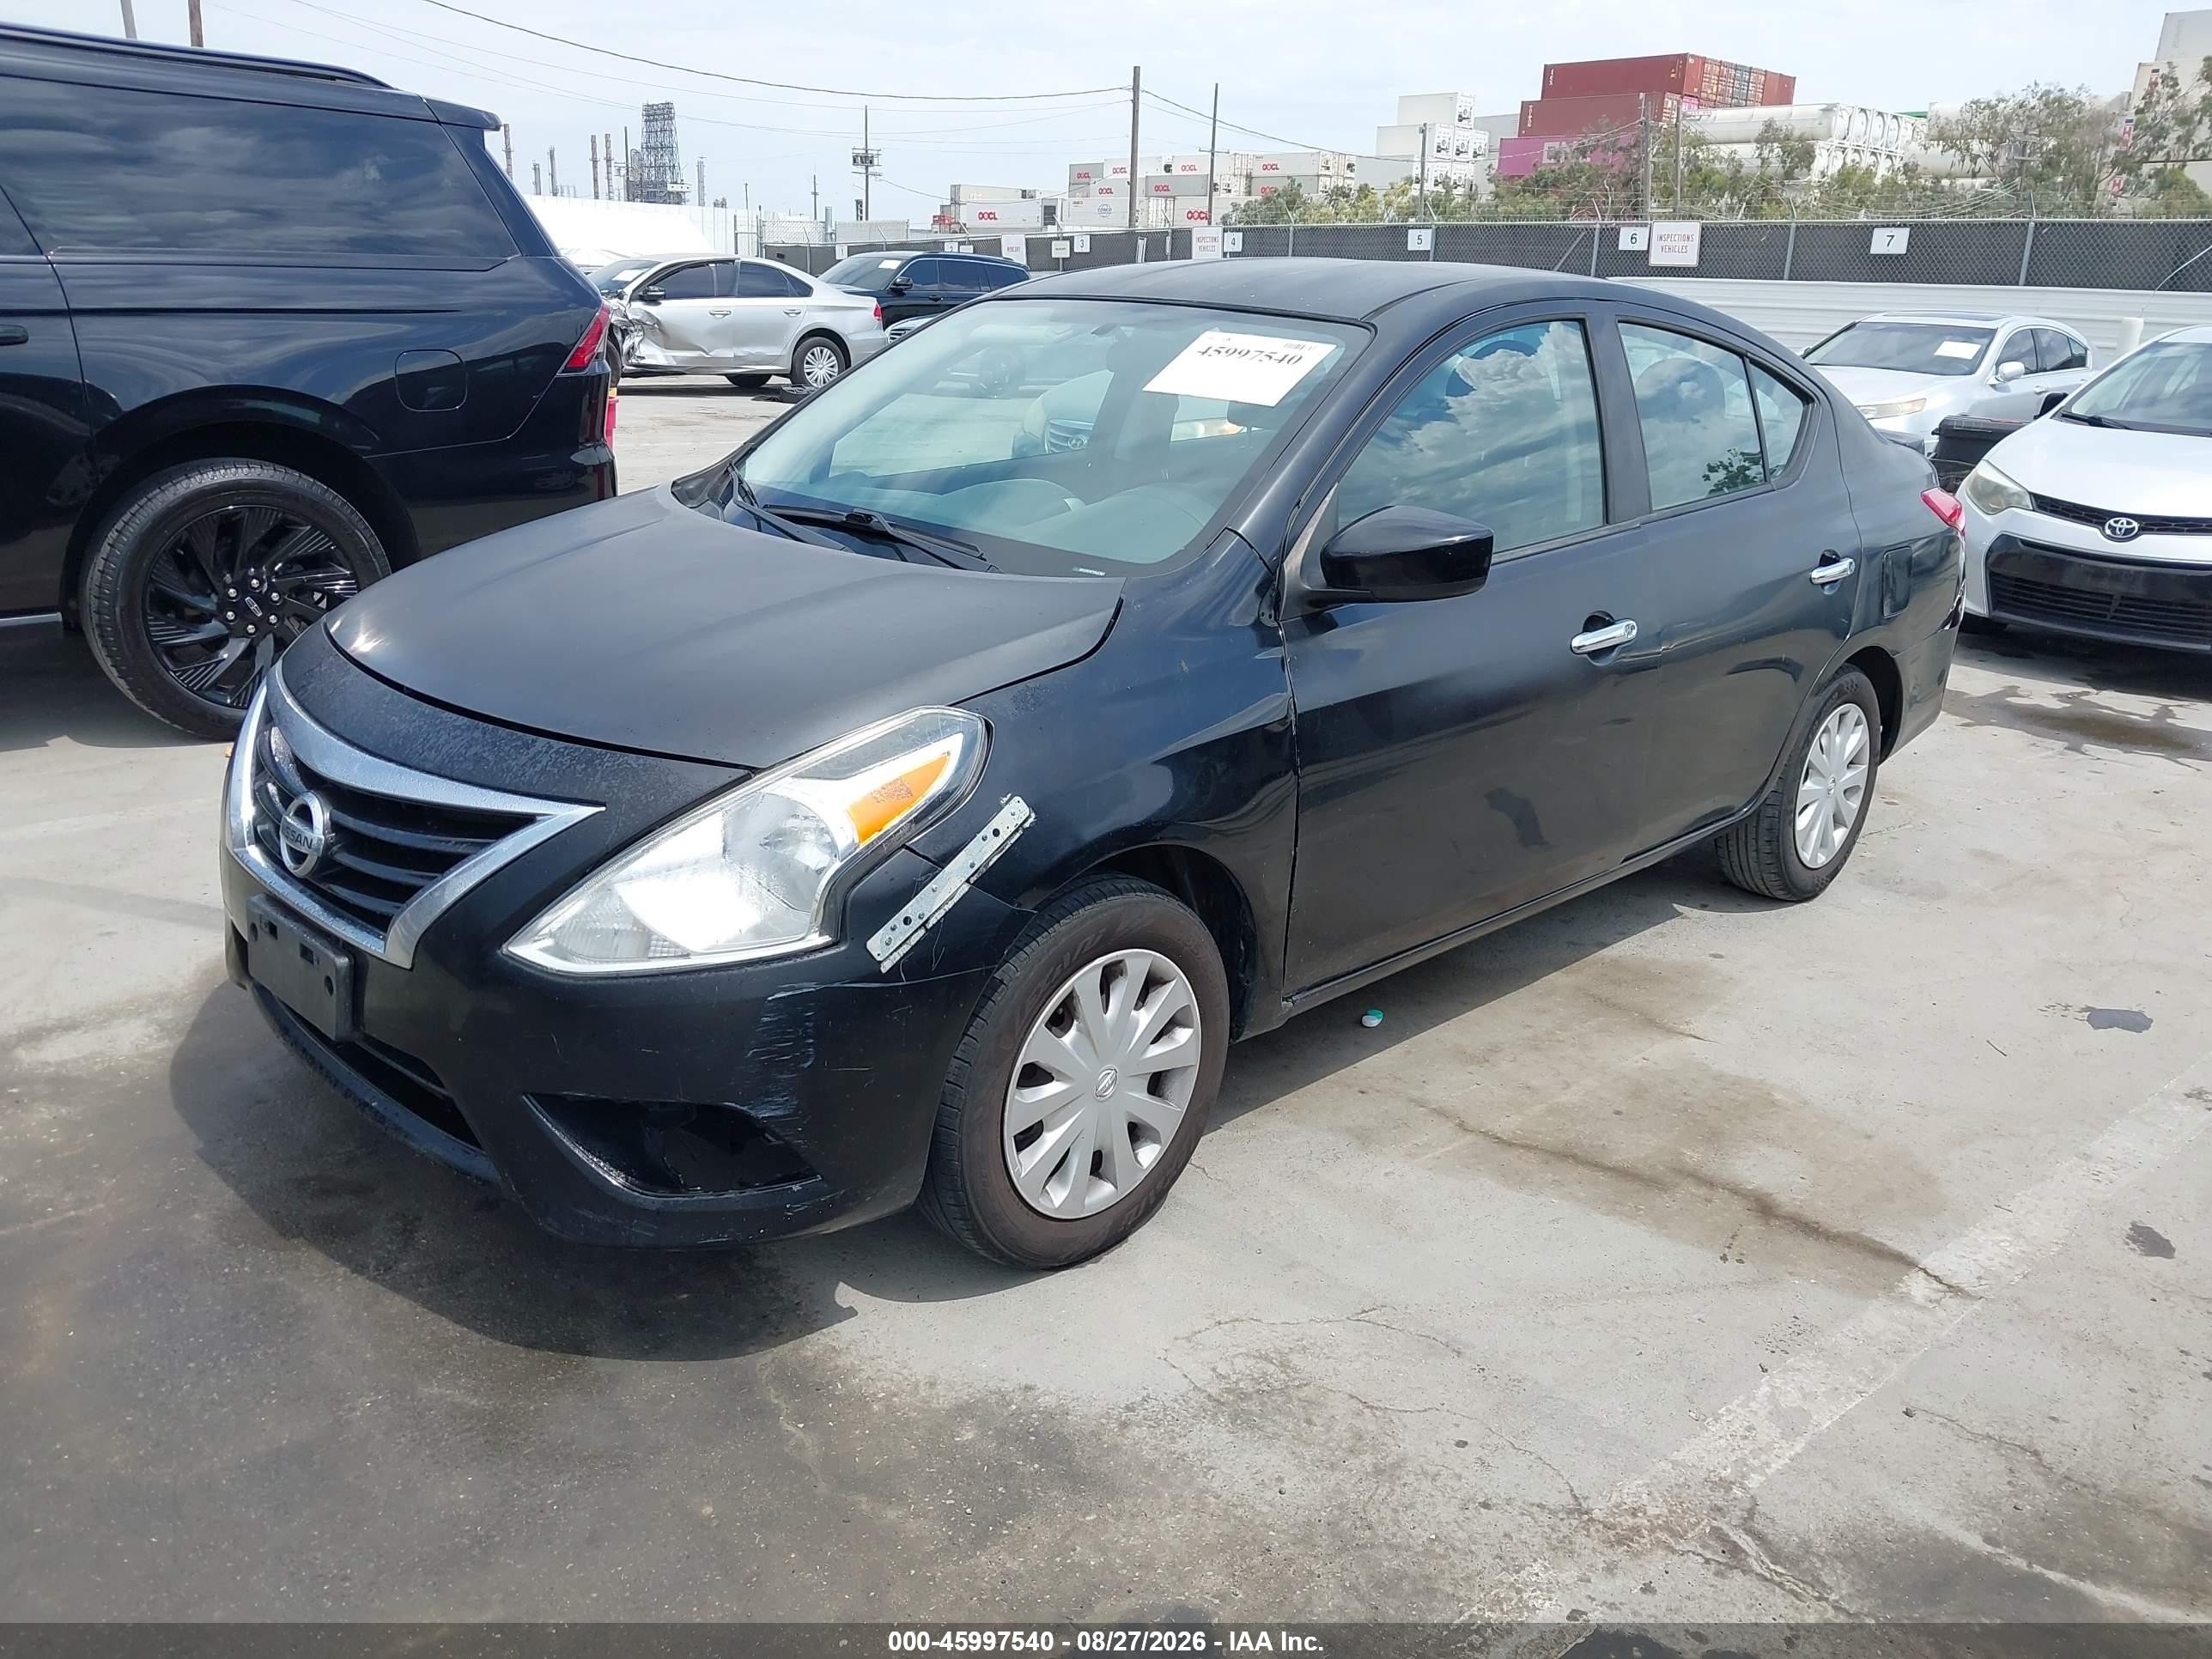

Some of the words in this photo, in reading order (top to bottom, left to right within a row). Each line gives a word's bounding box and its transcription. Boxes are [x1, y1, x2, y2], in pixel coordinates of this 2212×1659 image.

[977, 211, 998, 221] OOCL
[1231, 237, 1236, 246] 4
[1417, 234, 1423, 246] 5
[1630, 233, 1638, 245] 6
[1656, 233, 1695, 243] INSPECTIONS
[1886, 234, 1895, 247] 7
[1079, 239, 1085, 248] 3
[1661, 245, 1688, 254] VEHICLES
[1197, 345, 1304, 365] 45997540
